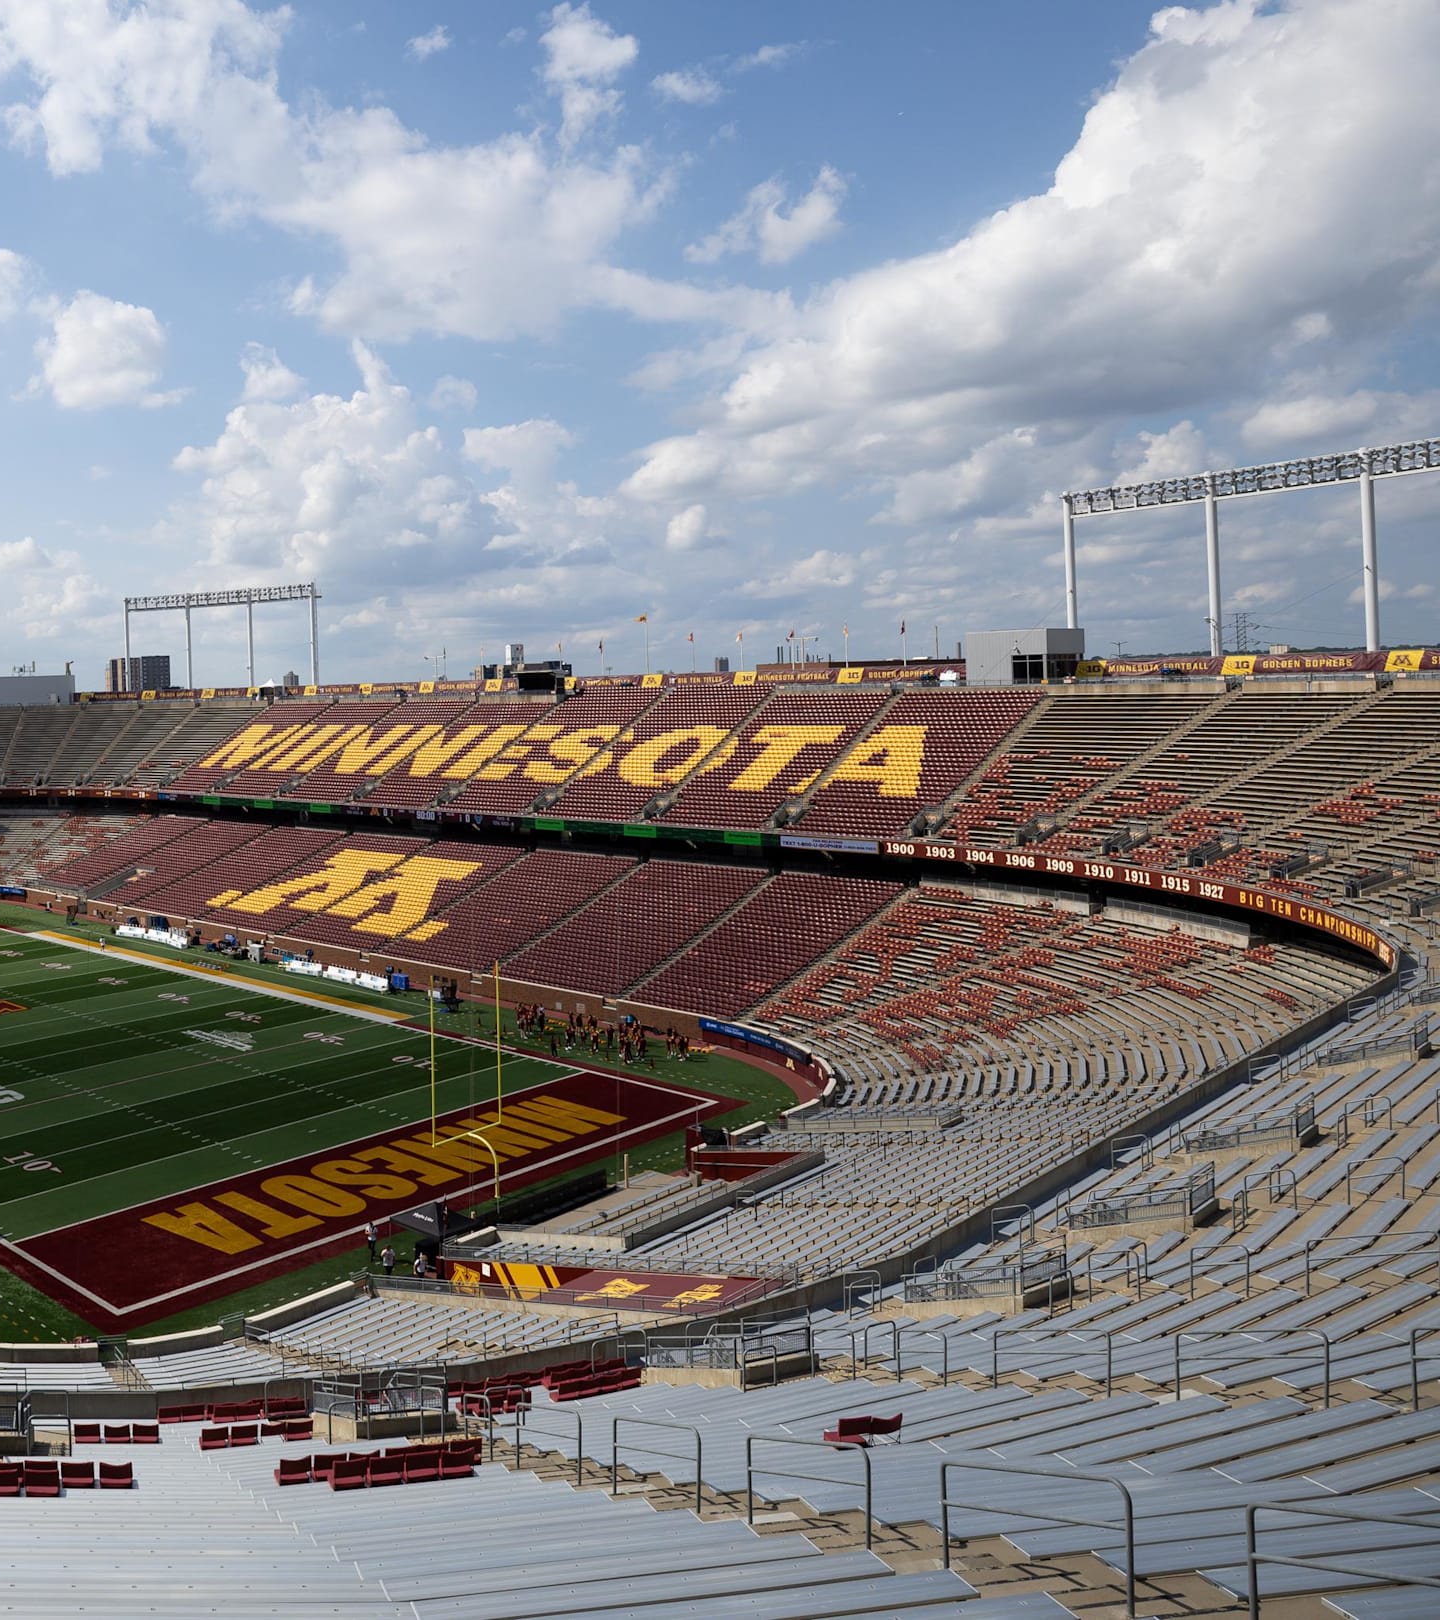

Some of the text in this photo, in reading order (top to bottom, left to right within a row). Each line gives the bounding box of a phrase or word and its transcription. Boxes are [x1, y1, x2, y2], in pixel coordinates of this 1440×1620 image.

[1108, 663, 1160, 673] MINNESOTA
[1262, 657, 1353, 669] GOLDEN GOPHERS
[196, 724, 930, 799] MINNESOTA
[416, 811, 436, 820] 90:00
[886, 842, 915, 855] 1900
[925, 846, 956, 859] 1903
[966, 850, 995, 864] 1904
[1005, 854, 1036, 868] 1906
[1045, 858, 1074, 873] 1909
[1084, 863, 1114, 879] 1910
[1124, 869, 1151, 885] 1911
[1161, 875, 1190, 892] 1915
[1199, 882, 1224, 899] 1927
[1239, 891, 1264, 909] BIG
[1271, 898, 1291, 917] TEN
[1300, 903, 1376, 949] CHAMPIONSHIPS
[391, 1055, 438, 1072] 10
[2, 1151, 53, 1171] 10
[141, 1095, 628, 1255] MINNESOTA
